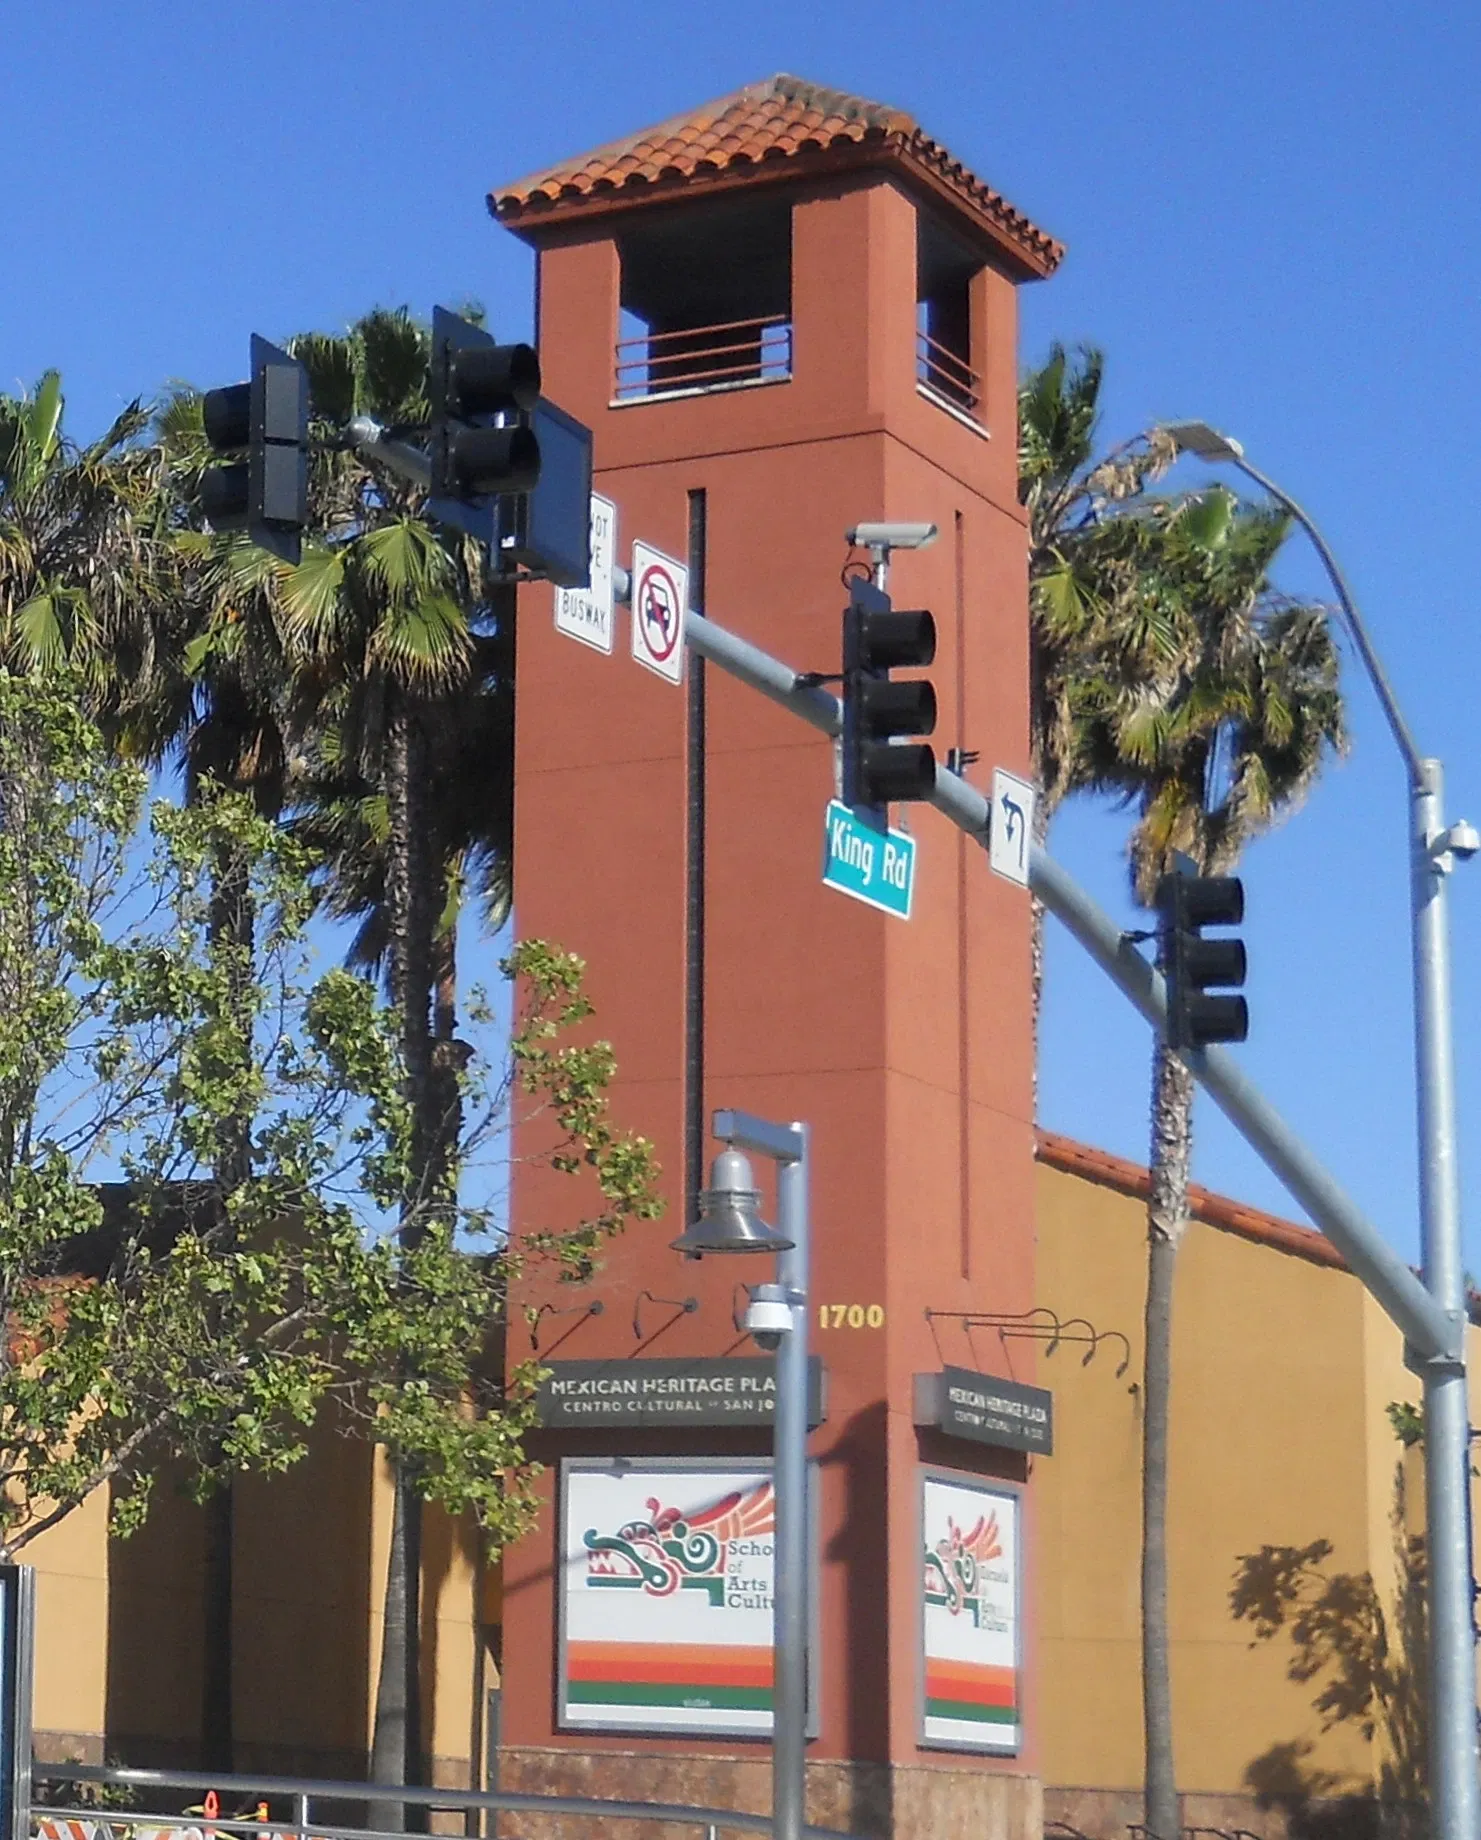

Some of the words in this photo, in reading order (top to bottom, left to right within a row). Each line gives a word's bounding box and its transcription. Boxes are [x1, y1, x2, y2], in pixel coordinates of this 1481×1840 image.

[592, 512, 608, 537] OT
[562, 591, 606, 634] BUSWAY
[832, 818, 873, 886] King
[882, 842, 908, 889] Rd
[820, 1304, 884, 1329] 1700
[550, 1379, 637, 1395] MEXICAN
[643, 1377, 734, 1394] HERITAGE
[563, 1400, 622, 1413] CENTRO
[723, 1399, 754, 1411] SAN
[728, 1540, 774, 1556] Scho
[728, 1560, 744, 1574] of
[727, 1576, 767, 1591] Arts
